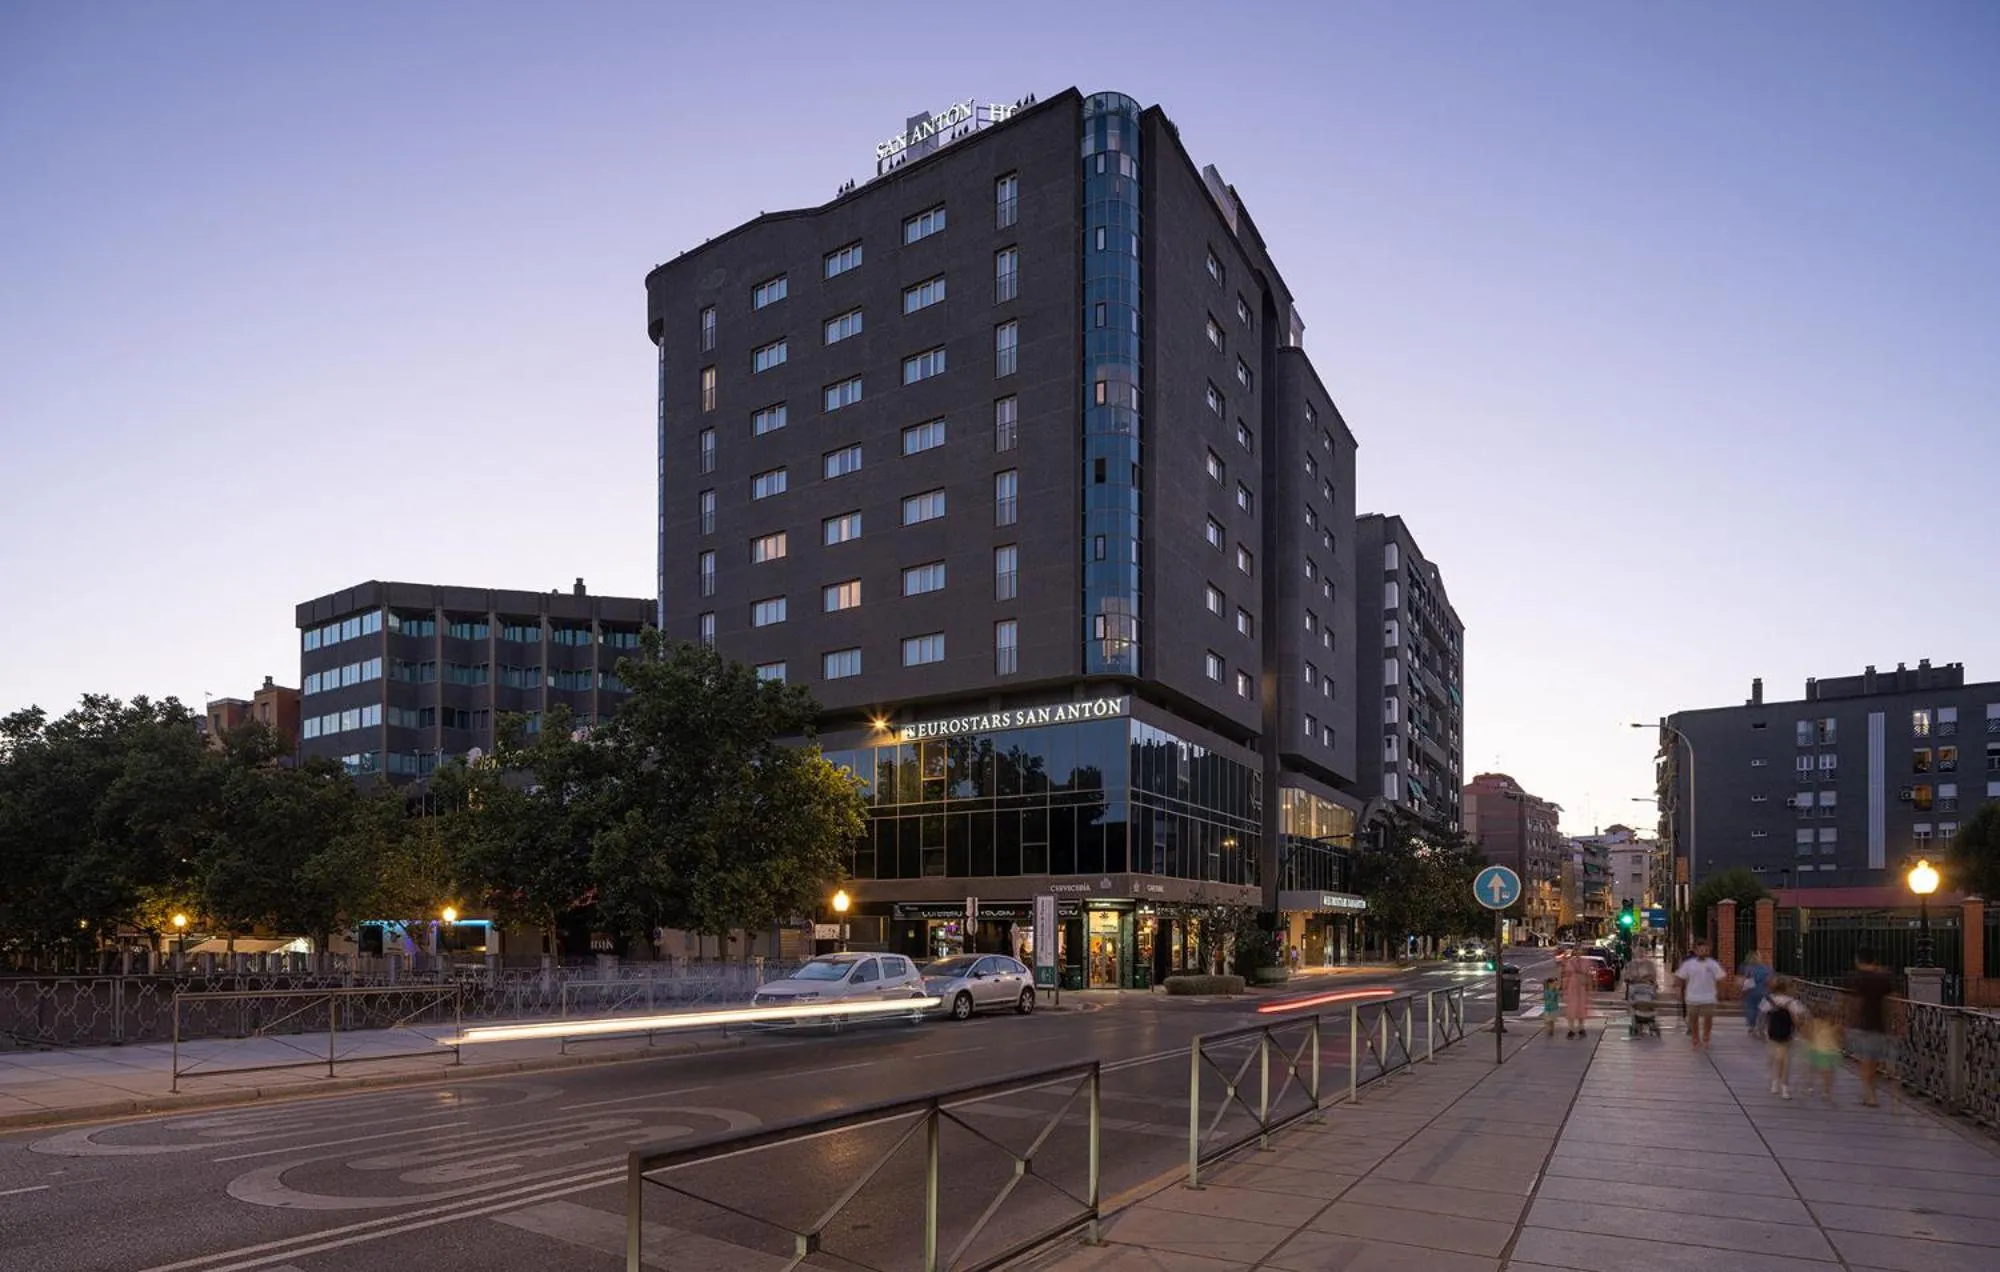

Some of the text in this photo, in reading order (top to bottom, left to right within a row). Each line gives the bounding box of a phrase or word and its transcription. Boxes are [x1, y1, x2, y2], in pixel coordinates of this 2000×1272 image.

[876, 131, 907, 160] SAN
[911, 99, 974, 144] ANTÓN
[918, 698, 1122, 737] EUROSTARS SAN ANTÓN
